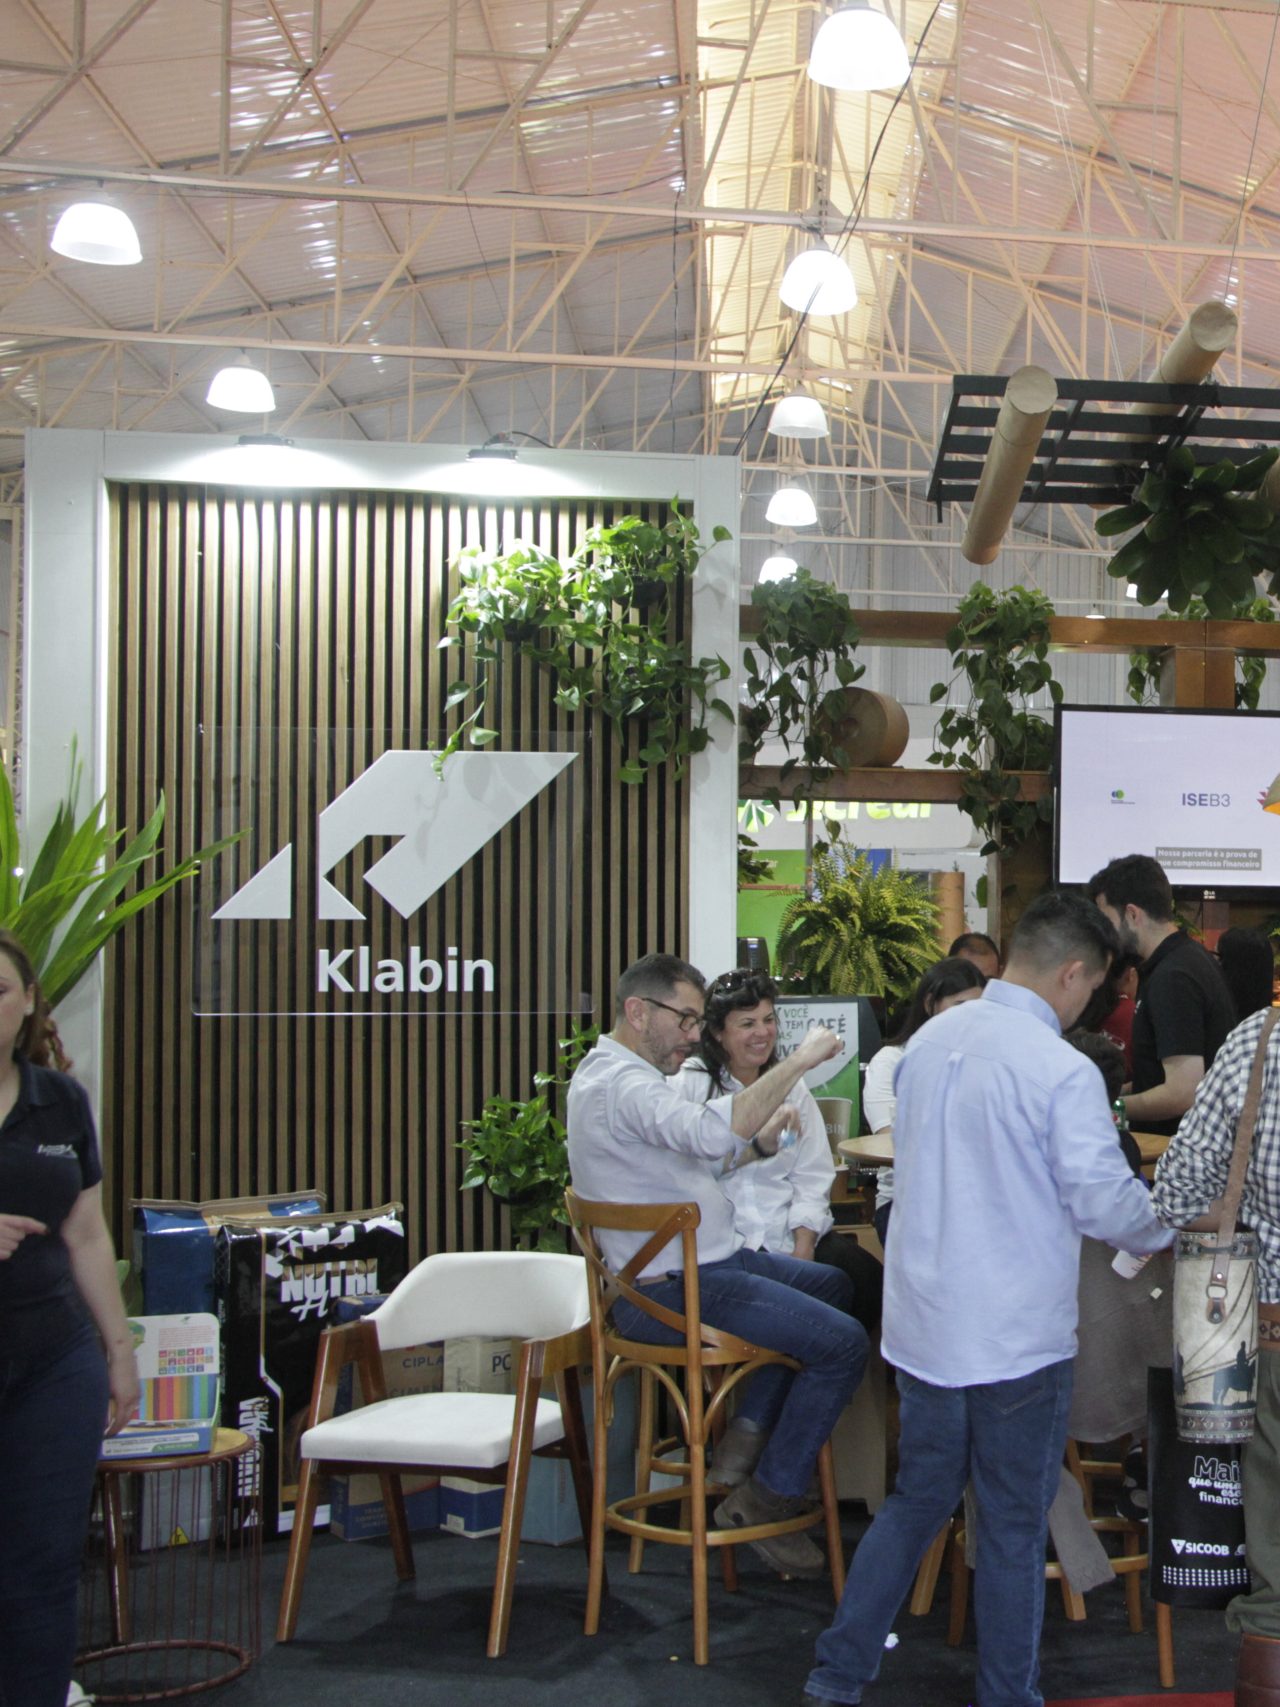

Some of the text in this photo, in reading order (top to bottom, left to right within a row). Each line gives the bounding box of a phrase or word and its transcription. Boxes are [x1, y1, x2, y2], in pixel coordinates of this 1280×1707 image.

[1182, 793, 1231, 807] ISEB3
[1158, 849, 1180, 857] Nossa
[1182, 850, 1212, 859] parceria
[1173, 860, 1221, 868] compromisso
[1223, 860, 1260, 869] financeiro
[317, 946, 494, 993] Klabin
[784, 1004, 809, 1018] VOCÊ
[785, 1021, 804, 1030] TEM
[281, 1258, 378, 1302] NUTRI
[1193, 1455, 1240, 1482] Mai
[1188, 1476, 1212, 1488] que
[1199, 1491, 1244, 1506] financ
[1185, 1542, 1230, 1556] SICOOB
